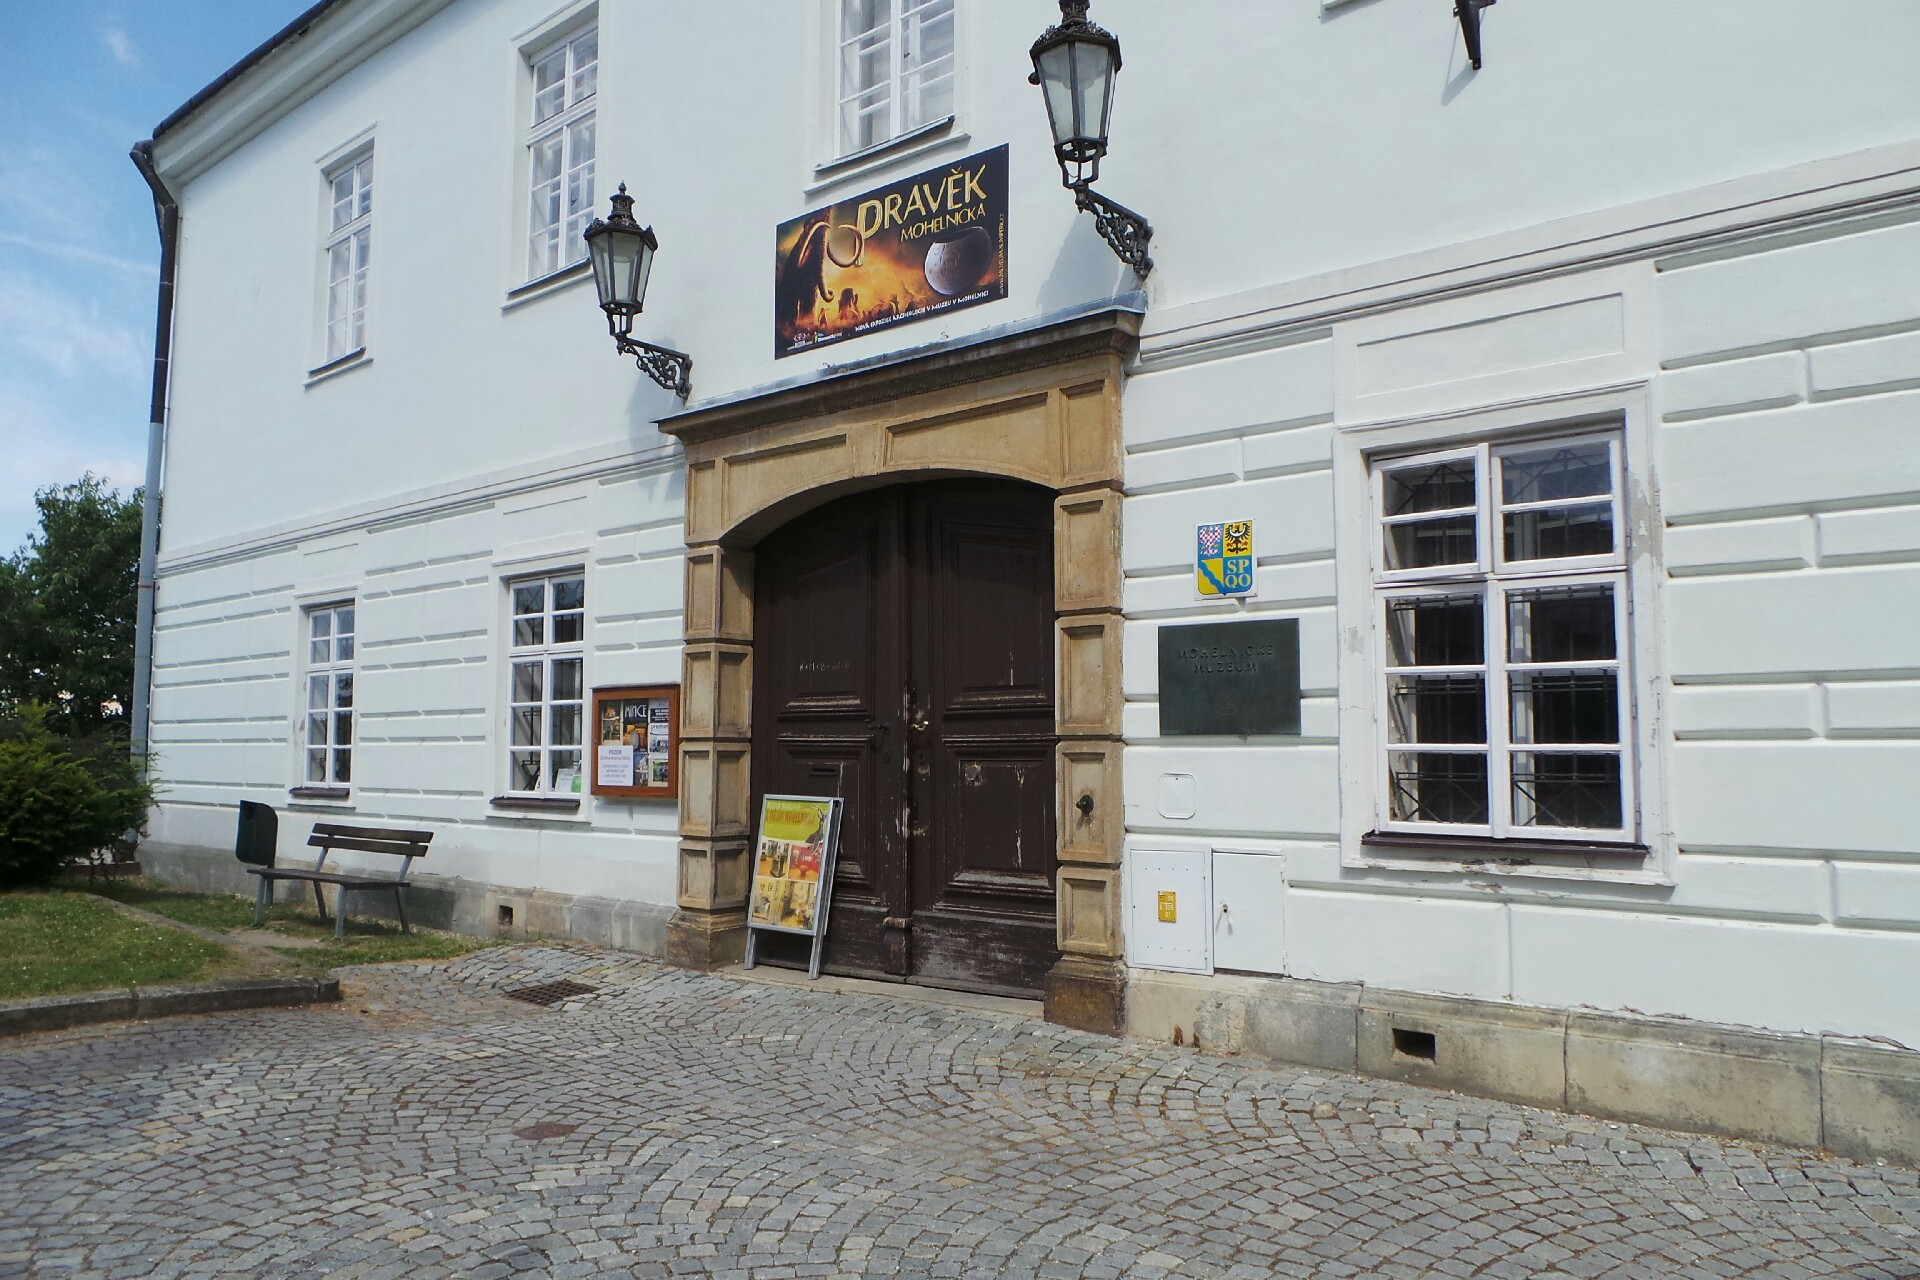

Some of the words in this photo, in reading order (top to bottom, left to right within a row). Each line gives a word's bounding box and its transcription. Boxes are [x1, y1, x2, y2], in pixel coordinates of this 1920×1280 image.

[900, 203, 986, 242] MOHELNICKA
[855, 321, 870, 332] NOVÁ
[931, 299, 952, 310] MUZEU
[957, 289, 989, 303] MOHELNICI
[1227, 559, 1250, 575] SP
[1225, 573, 1252, 588] QO
[1194, 661, 1258, 674] MUZEUM
